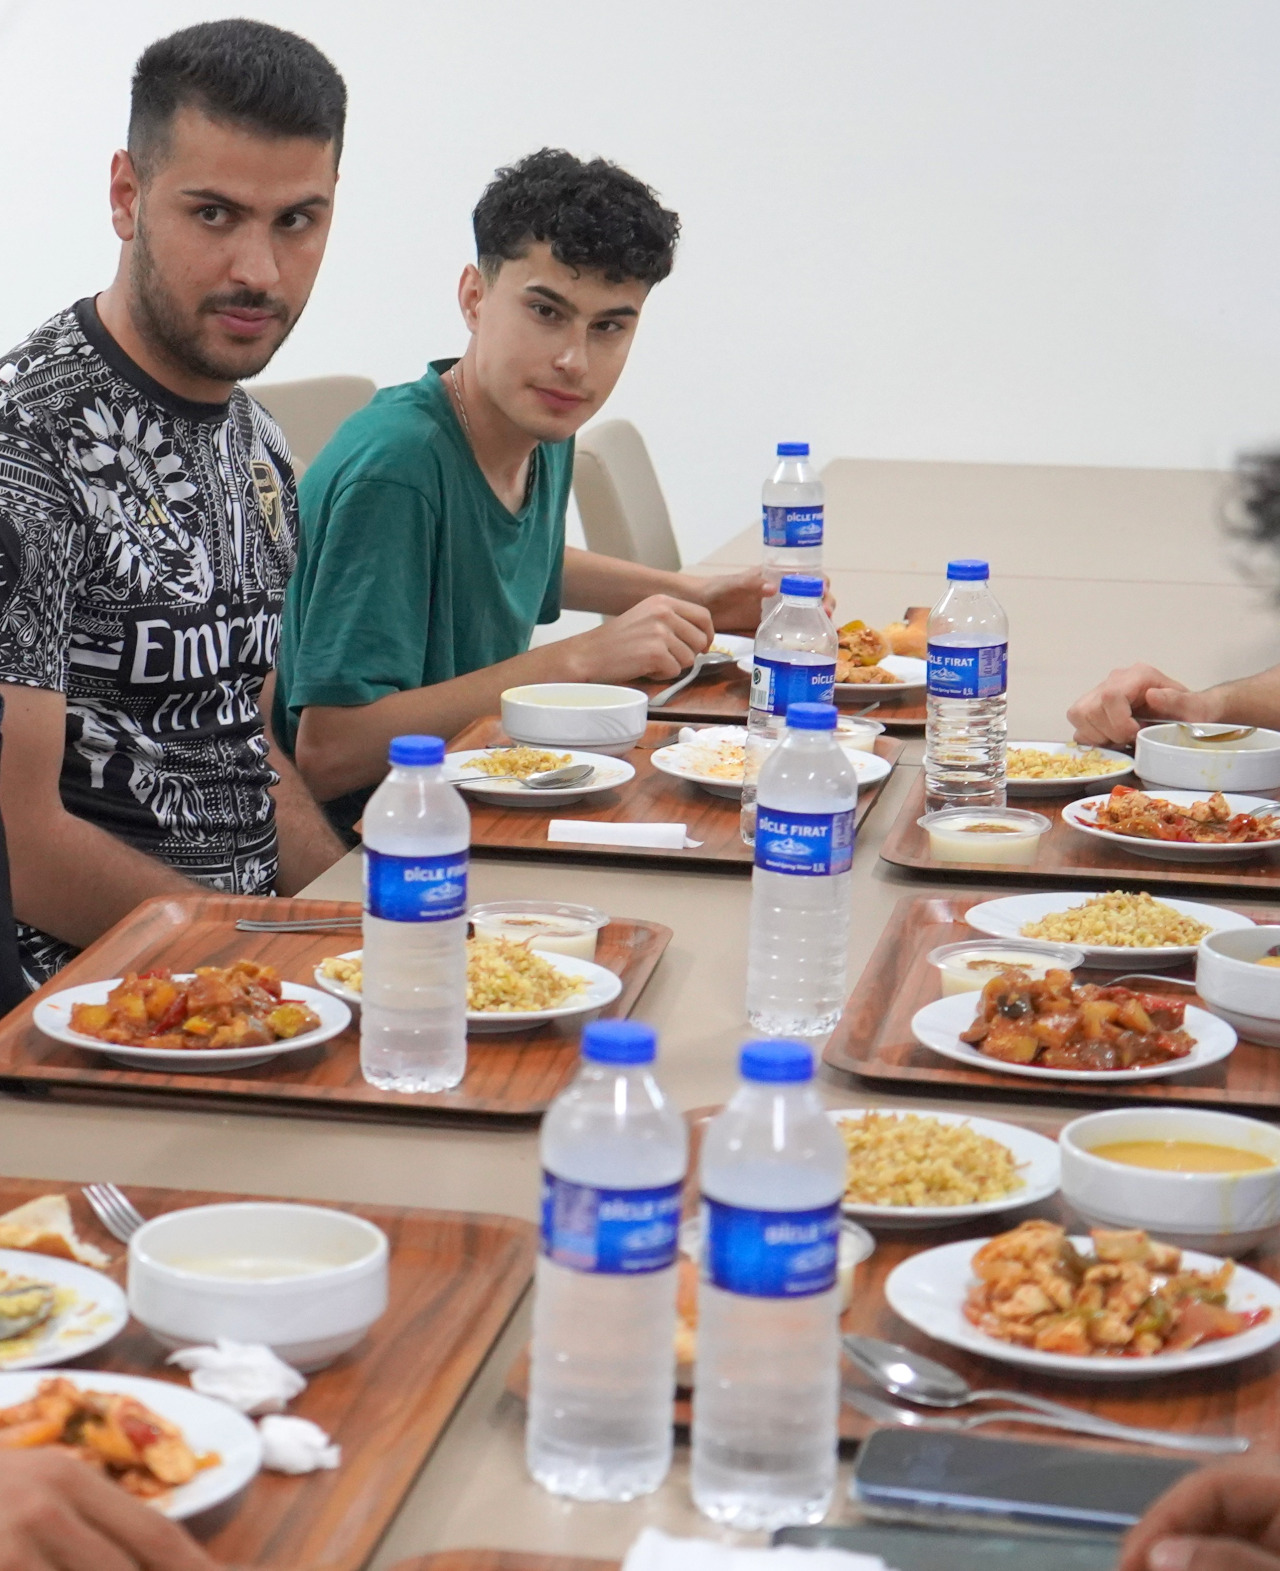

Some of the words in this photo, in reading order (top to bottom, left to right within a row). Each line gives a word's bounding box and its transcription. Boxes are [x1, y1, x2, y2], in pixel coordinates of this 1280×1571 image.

[130, 604, 283, 685] Emirate
[944, 657, 975, 667] FIRAT
[152, 688, 217, 733] FLY
[790, 825, 829, 837] FIRAT
